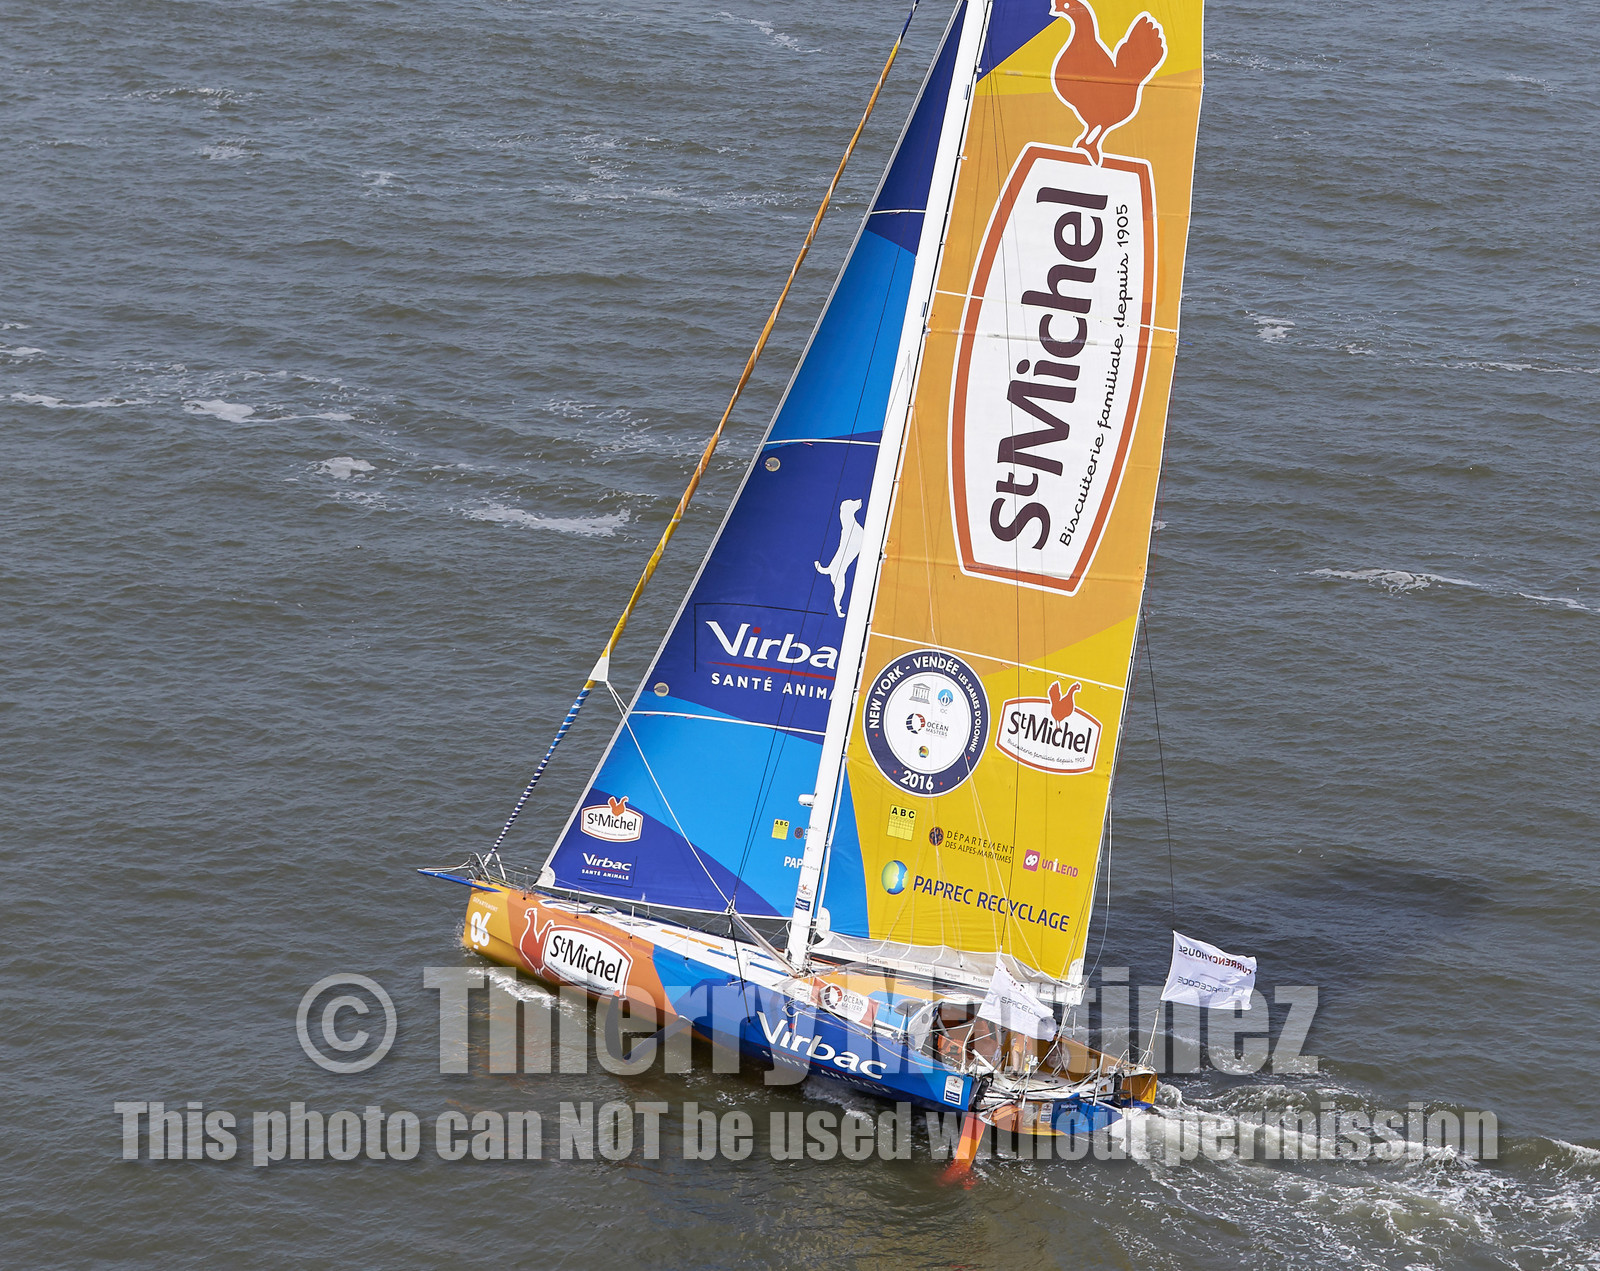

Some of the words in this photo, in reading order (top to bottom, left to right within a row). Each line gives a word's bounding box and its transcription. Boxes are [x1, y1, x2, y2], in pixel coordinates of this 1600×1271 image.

[1115, 204, 1129, 247] 1905
[1116, 254, 1133, 328] depuis
[1098, 336, 1124, 429] familiale
[1060, 433, 1105, 547] Biscuiterie
[912, 656, 960, 675] VENDÉE
[711, 672, 773, 692] SANTÉ
[875, 666, 904, 696] YORK
[958, 673, 968, 685] LES
[966, 683, 980, 709] SABLES
[869, 698, 882, 728] NEW
[926, 722, 949, 732] OCEAN
[926, 728, 947, 736] MASTERS
[900, 770, 934, 791] 2016
[945, 840, 957, 850] DES
[958, 846, 1012, 864] ALPES-MARITIMES
[947, 830, 1014, 855] DÉPARTEMENT
[582, 852, 632, 871] Virbac
[603, 872, 629, 880] ANIMALE
[914, 875, 973, 905] PAPREC
[977, 891, 1070, 932] RECYCLAGE
[470, 911, 492, 947] 06
[843, 994, 864, 1006] OCEAN
[757, 1011, 887, 1080] Virbac
